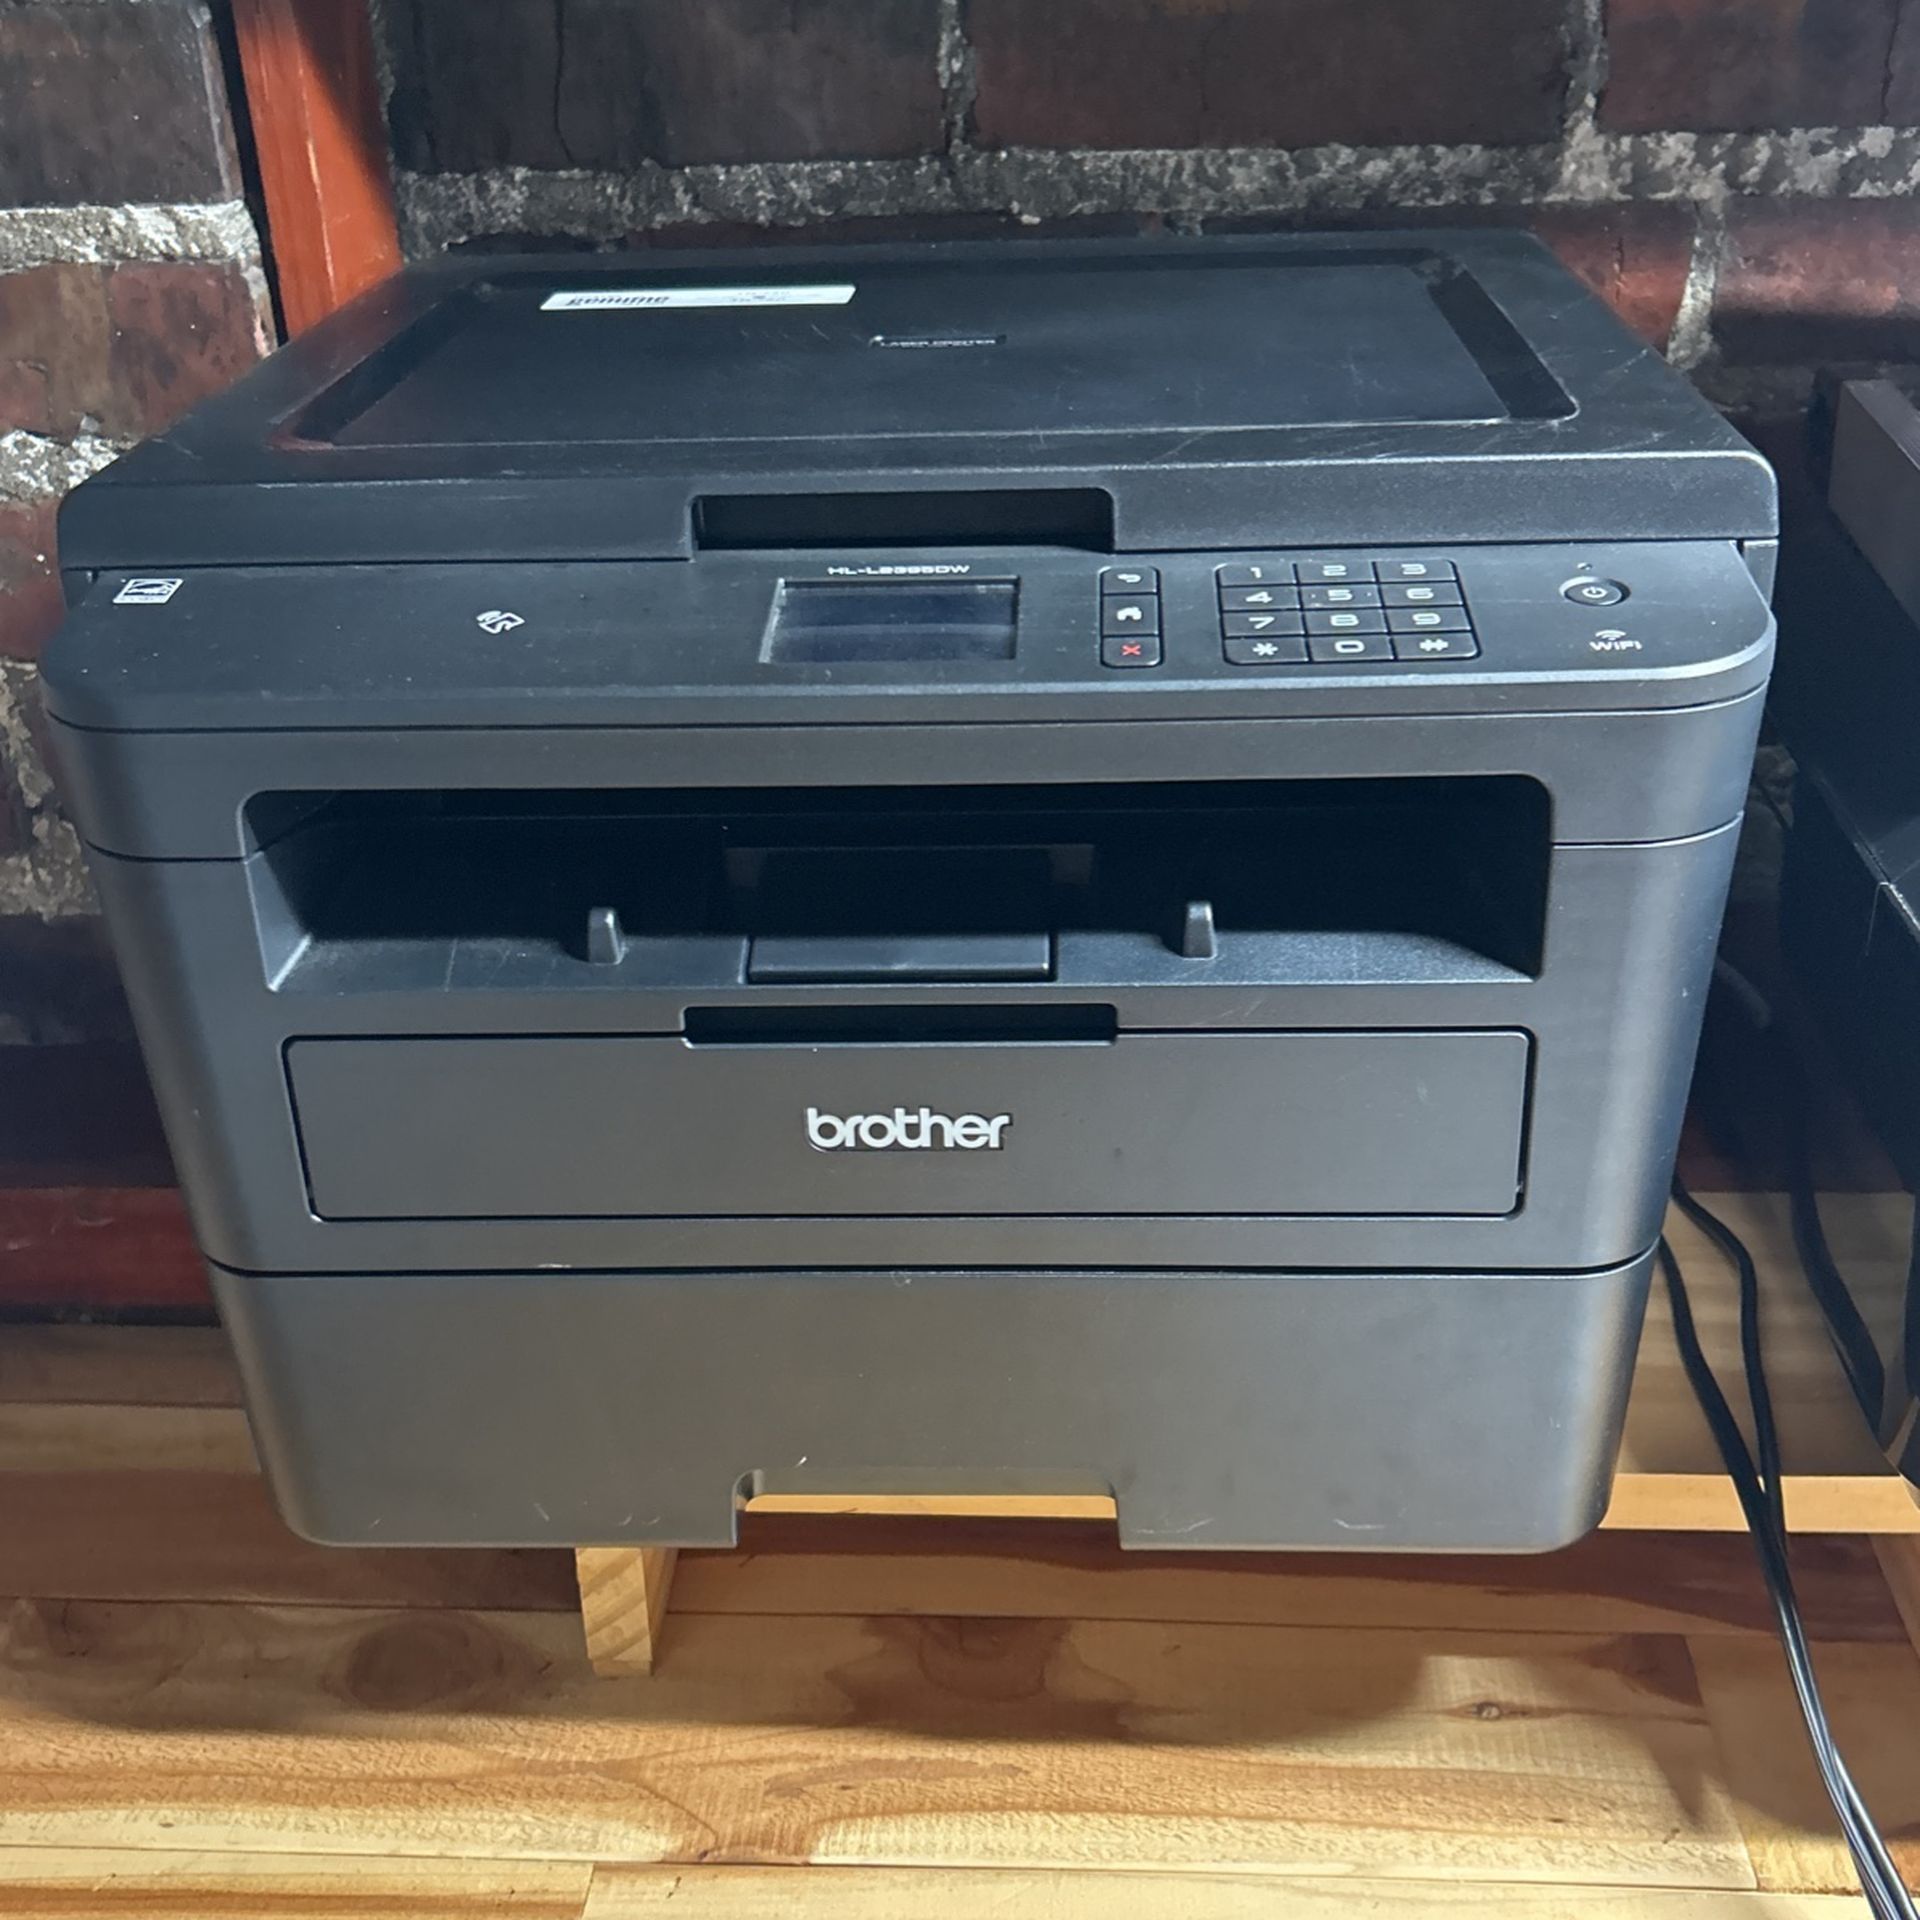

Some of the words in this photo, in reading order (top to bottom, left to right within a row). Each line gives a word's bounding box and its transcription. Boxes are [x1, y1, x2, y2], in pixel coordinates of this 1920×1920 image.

[1250, 566, 1262, 578] 1
[1323, 564, 1347, 576] 2
[1402, 563, 1427, 575] 3
[1246, 591, 1273, 603] 4
[1328, 589, 1352, 601] 5
[1406, 587, 1434, 600] 6
[1249, 616, 1275, 629] 7
[1330, 614, 1359, 627] 8
[1412, 612, 1441, 625] 9
[1334, 640, 1365, 653] 0
[807, 1107, 1010, 1149] brother
